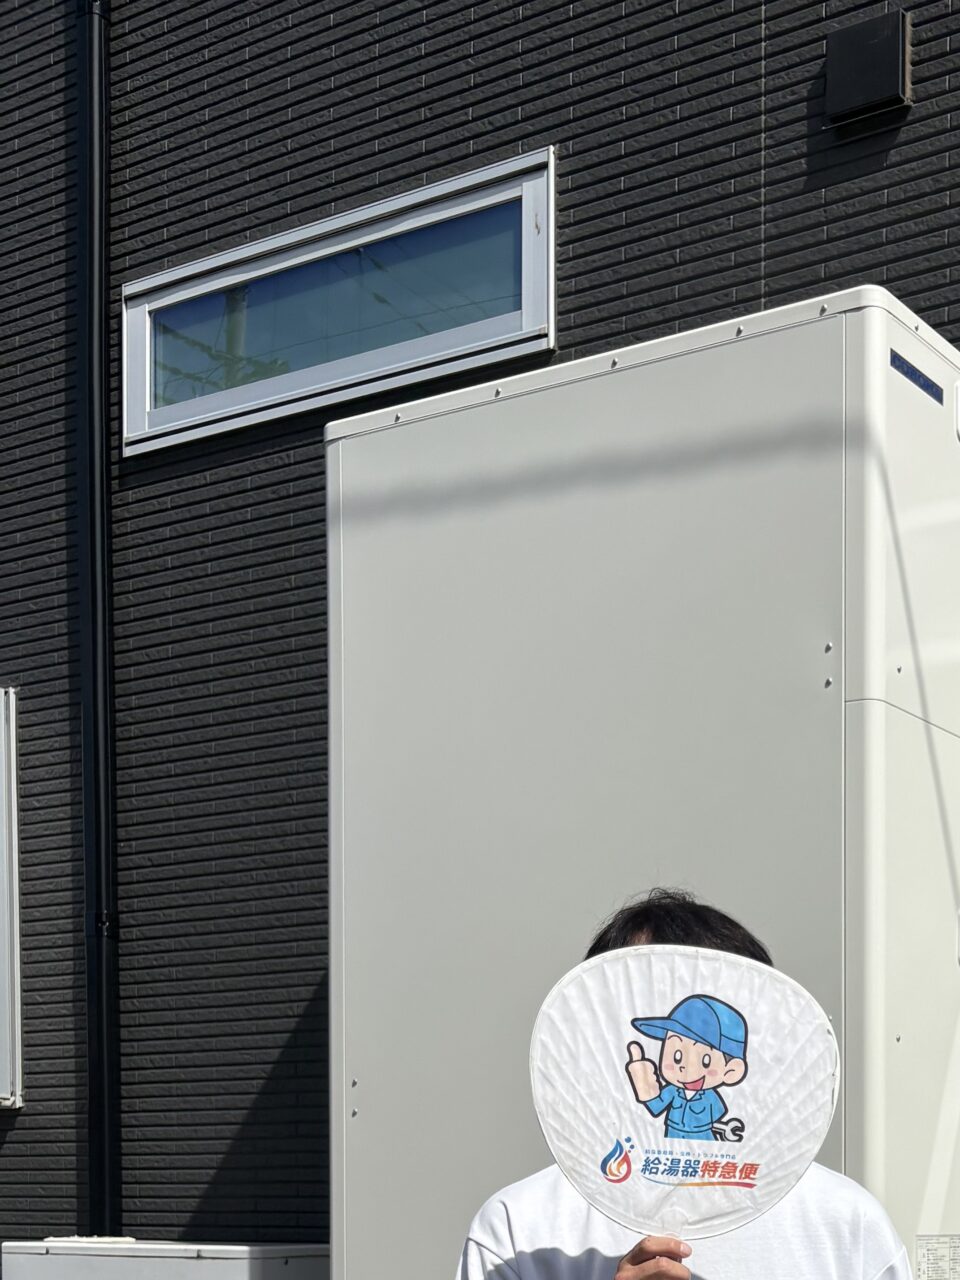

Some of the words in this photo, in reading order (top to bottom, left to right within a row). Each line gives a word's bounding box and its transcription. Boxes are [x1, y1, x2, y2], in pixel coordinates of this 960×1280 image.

[641, 1157, 760, 1180] 給湯器特急便
